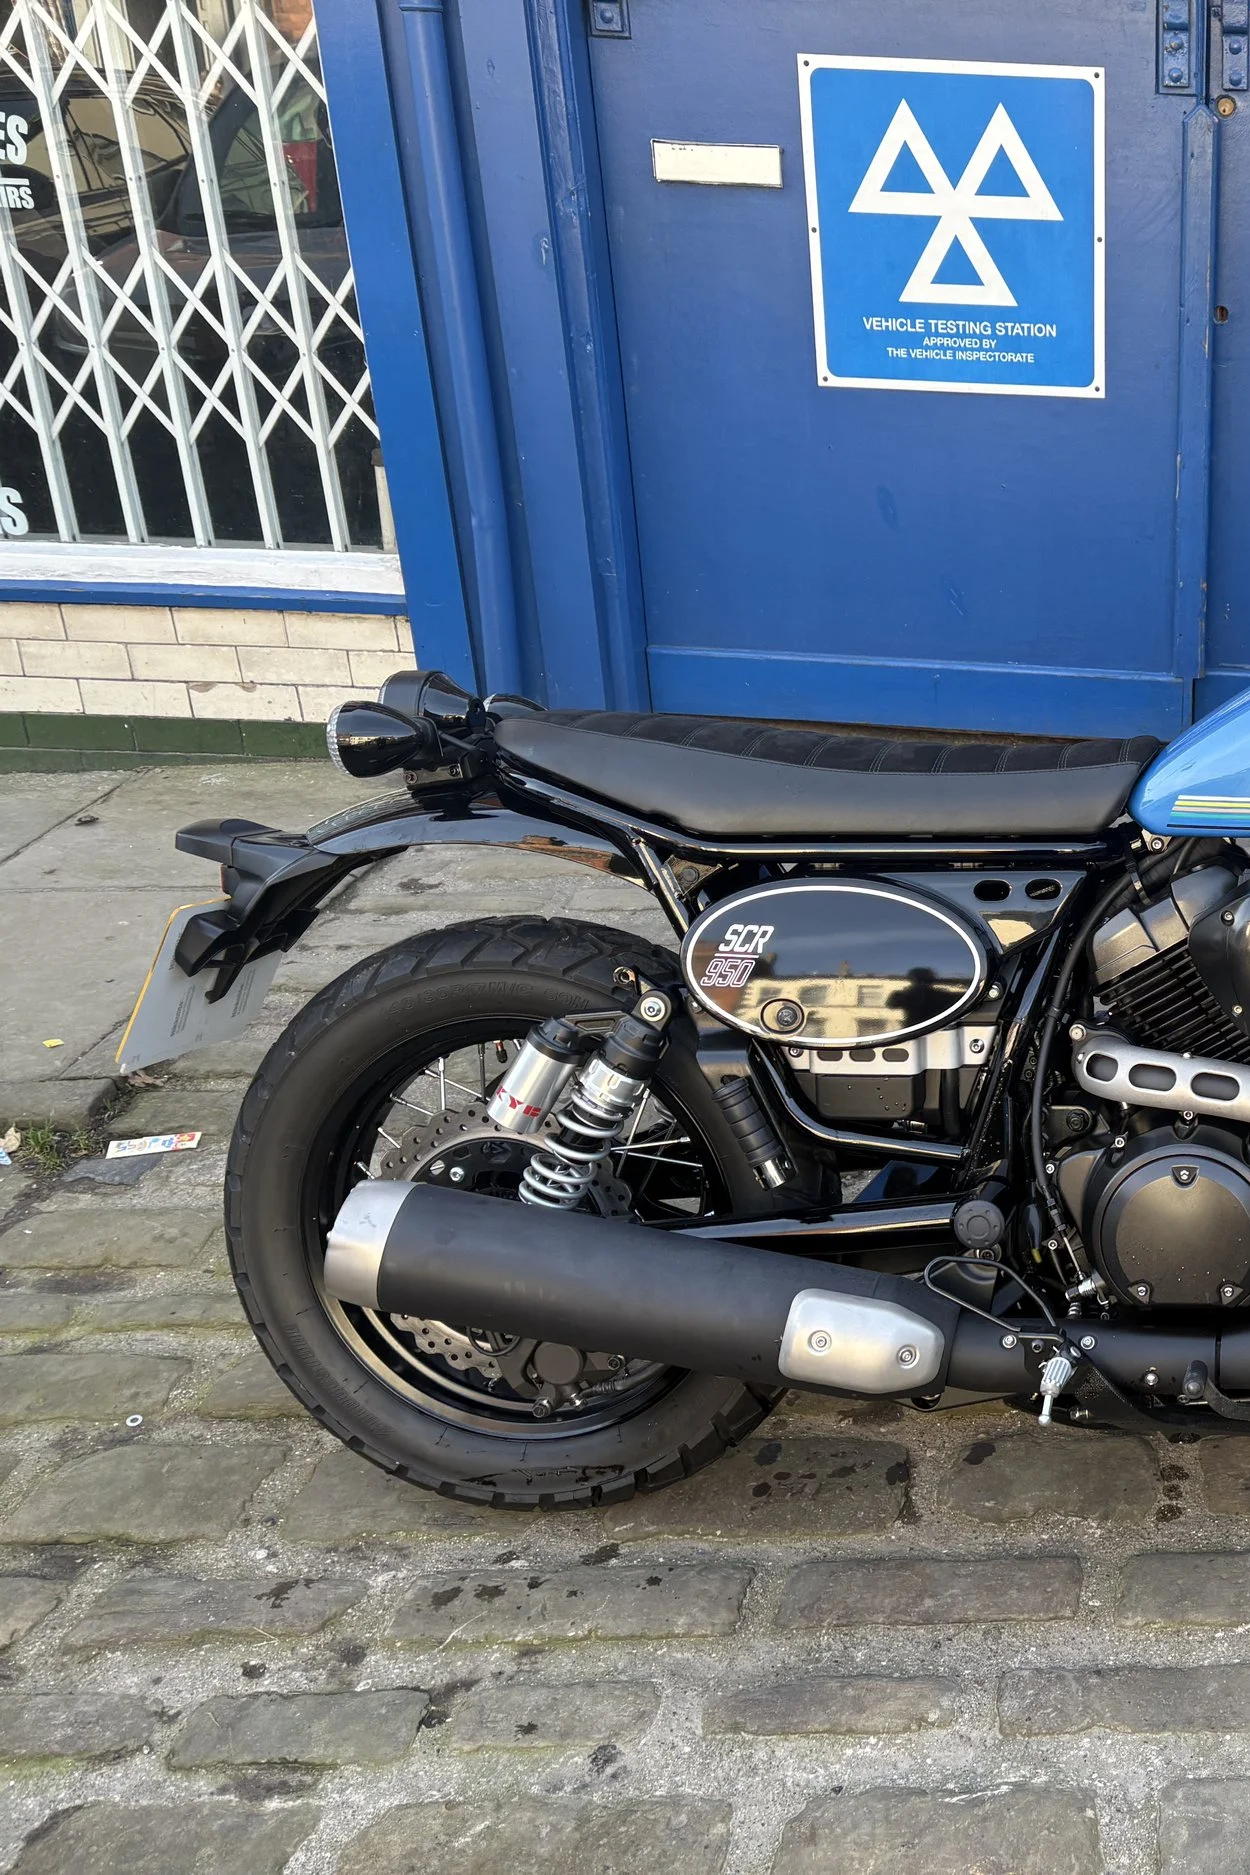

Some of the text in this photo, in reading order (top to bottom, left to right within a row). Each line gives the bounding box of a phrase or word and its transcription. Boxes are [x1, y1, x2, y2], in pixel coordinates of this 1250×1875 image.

[863, 317, 1057, 338] VEHICLE TESTING STATION
[923, 337, 997, 348] APPROVED BY
[887, 347, 1035, 363] THE VEHICLE INSPECTORATE
[718, 924, 774, 953] SCR
[700, 958, 756, 987] 950
